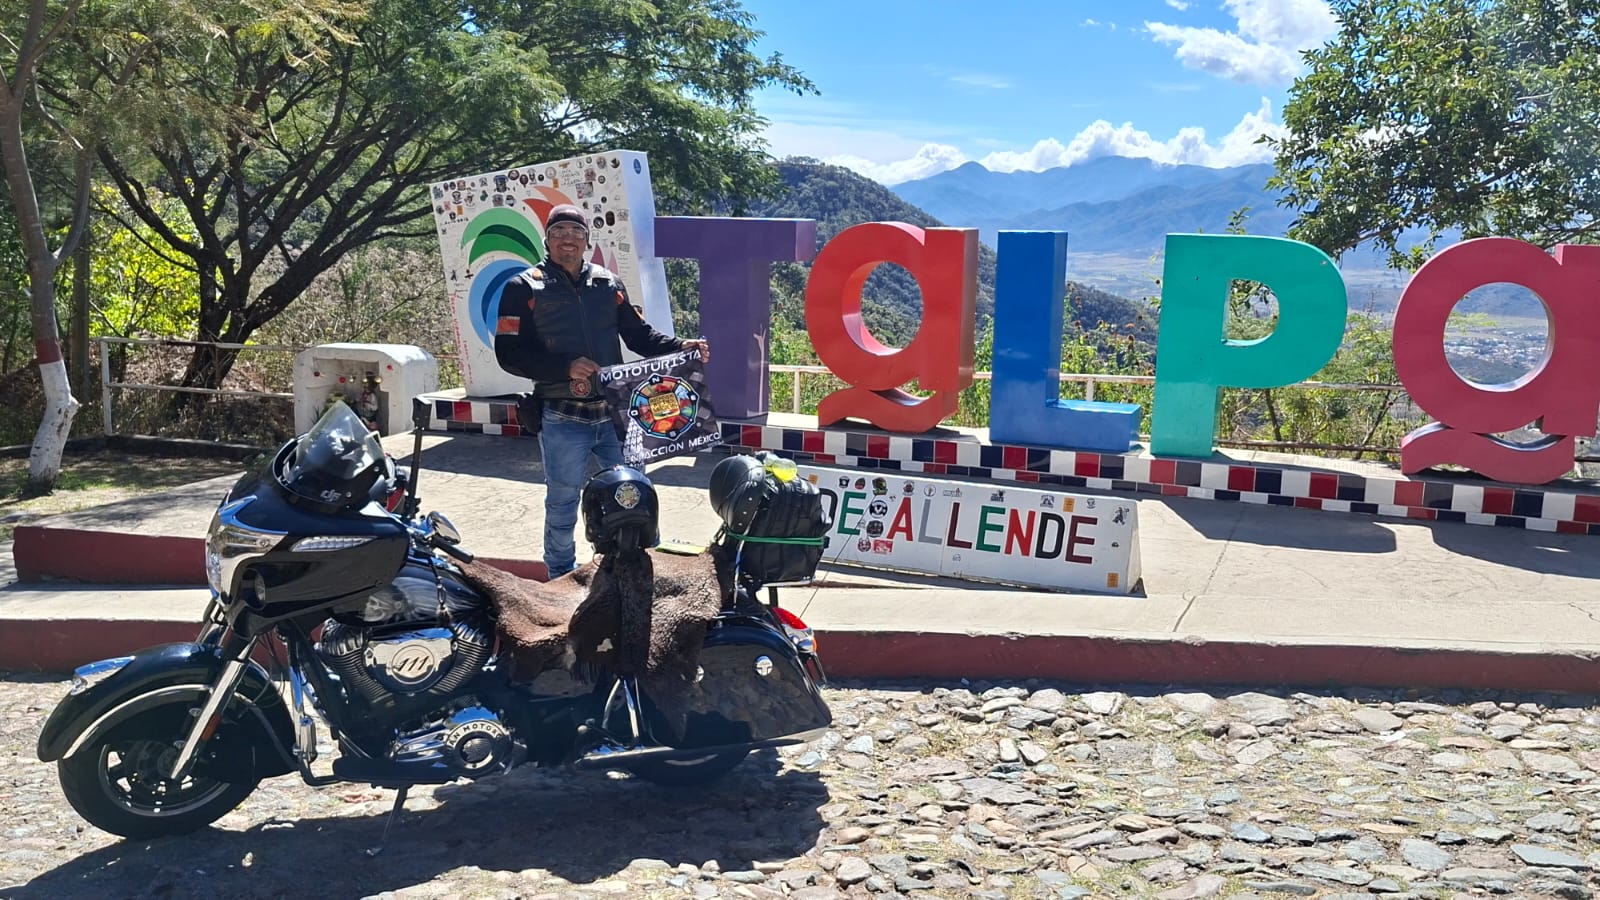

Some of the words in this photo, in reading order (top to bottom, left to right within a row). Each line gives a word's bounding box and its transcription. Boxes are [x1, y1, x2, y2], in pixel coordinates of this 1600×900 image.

[600, 349, 702, 383] MOTOTURISTA
[886, 497, 1098, 564] ALLENDE
[400, 656, 430, 672] 111
